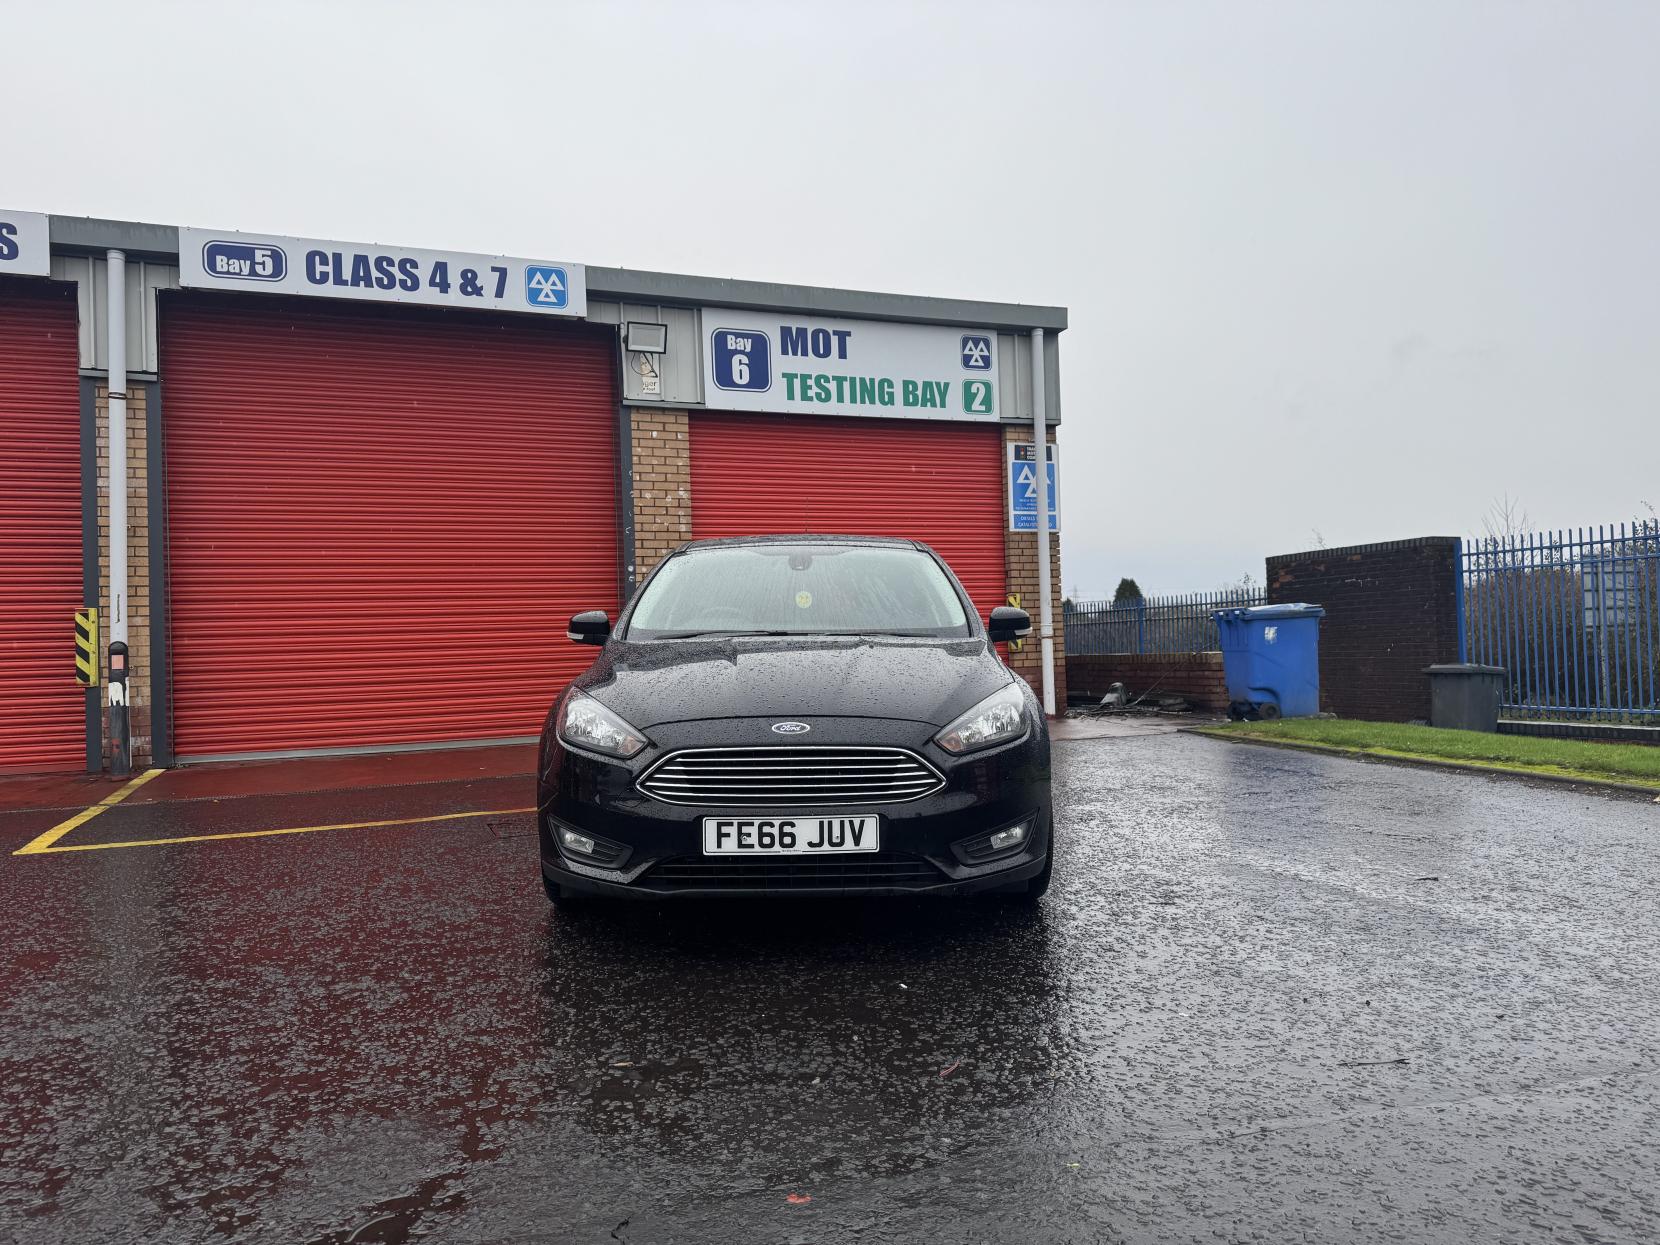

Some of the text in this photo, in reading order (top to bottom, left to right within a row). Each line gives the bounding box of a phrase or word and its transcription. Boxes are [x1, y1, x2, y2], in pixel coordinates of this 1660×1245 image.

[215, 249, 274, 276] Bay 5
[306, 250, 508, 299] CLASS 4 & 7
[726, 334, 752, 353] Bay
[780, 325, 852, 360] MOT
[731, 353, 750, 385] 6
[781, 372, 951, 409] TESTING BAY
[970, 382, 986, 411] 2
[716, 819, 866, 849] FE66 JUV
